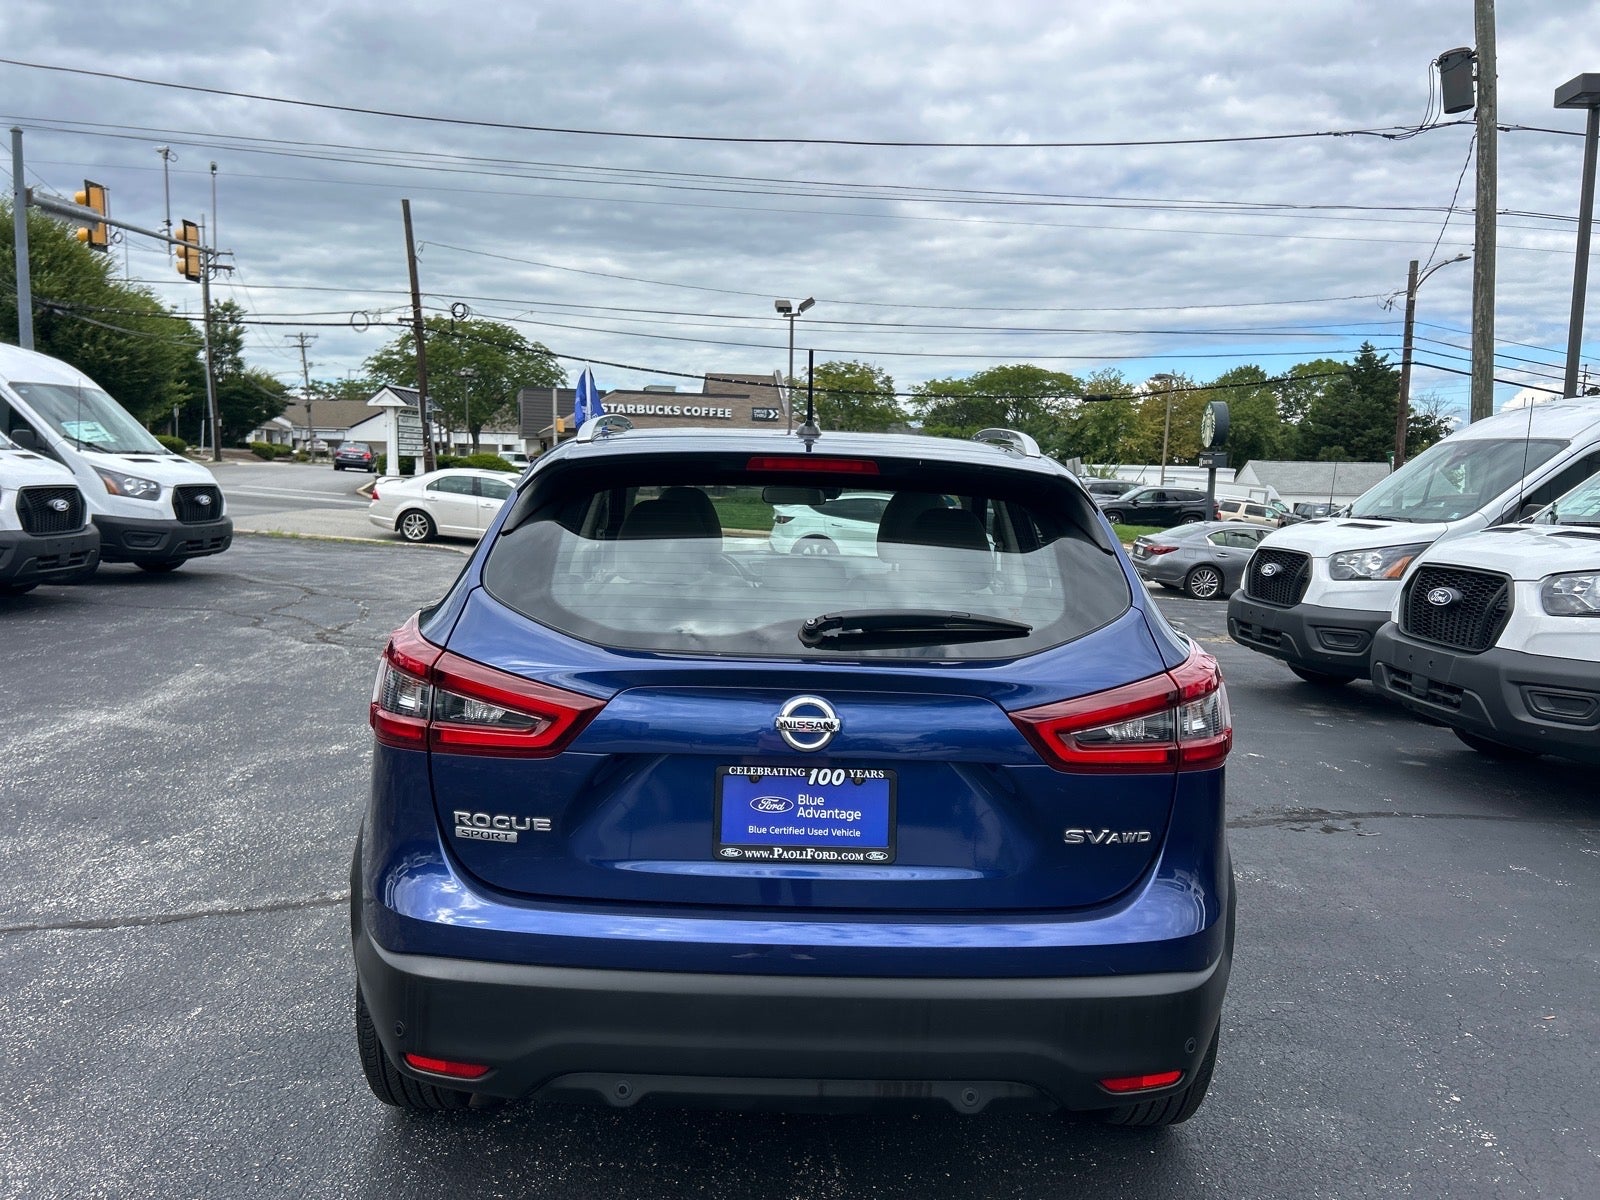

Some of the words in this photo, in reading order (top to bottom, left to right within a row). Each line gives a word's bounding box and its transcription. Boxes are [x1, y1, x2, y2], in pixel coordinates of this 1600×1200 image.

[601, 403, 681, 416] STARBUCKS
[683, 406, 732, 418] COFFEE
[1430, 589, 1449, 603] Ford
[783, 720, 834, 731] NISSAN
[728, 766, 806, 777] CELEBRATING
[808, 768, 846, 786] 100
[849, 769, 885, 779] YEARS
[756, 797, 787, 812] Ford
[798, 794, 825, 806] Blue
[453, 810, 552, 831] ROGUE
[797, 807, 862, 822] Advantage
[461, 829, 512, 841] SPORT
[748, 825, 767, 834] Blue
[769, 826, 805, 836] Certified
[807, 827, 829, 837] Used
[831, 828, 861, 837] Vehicle
